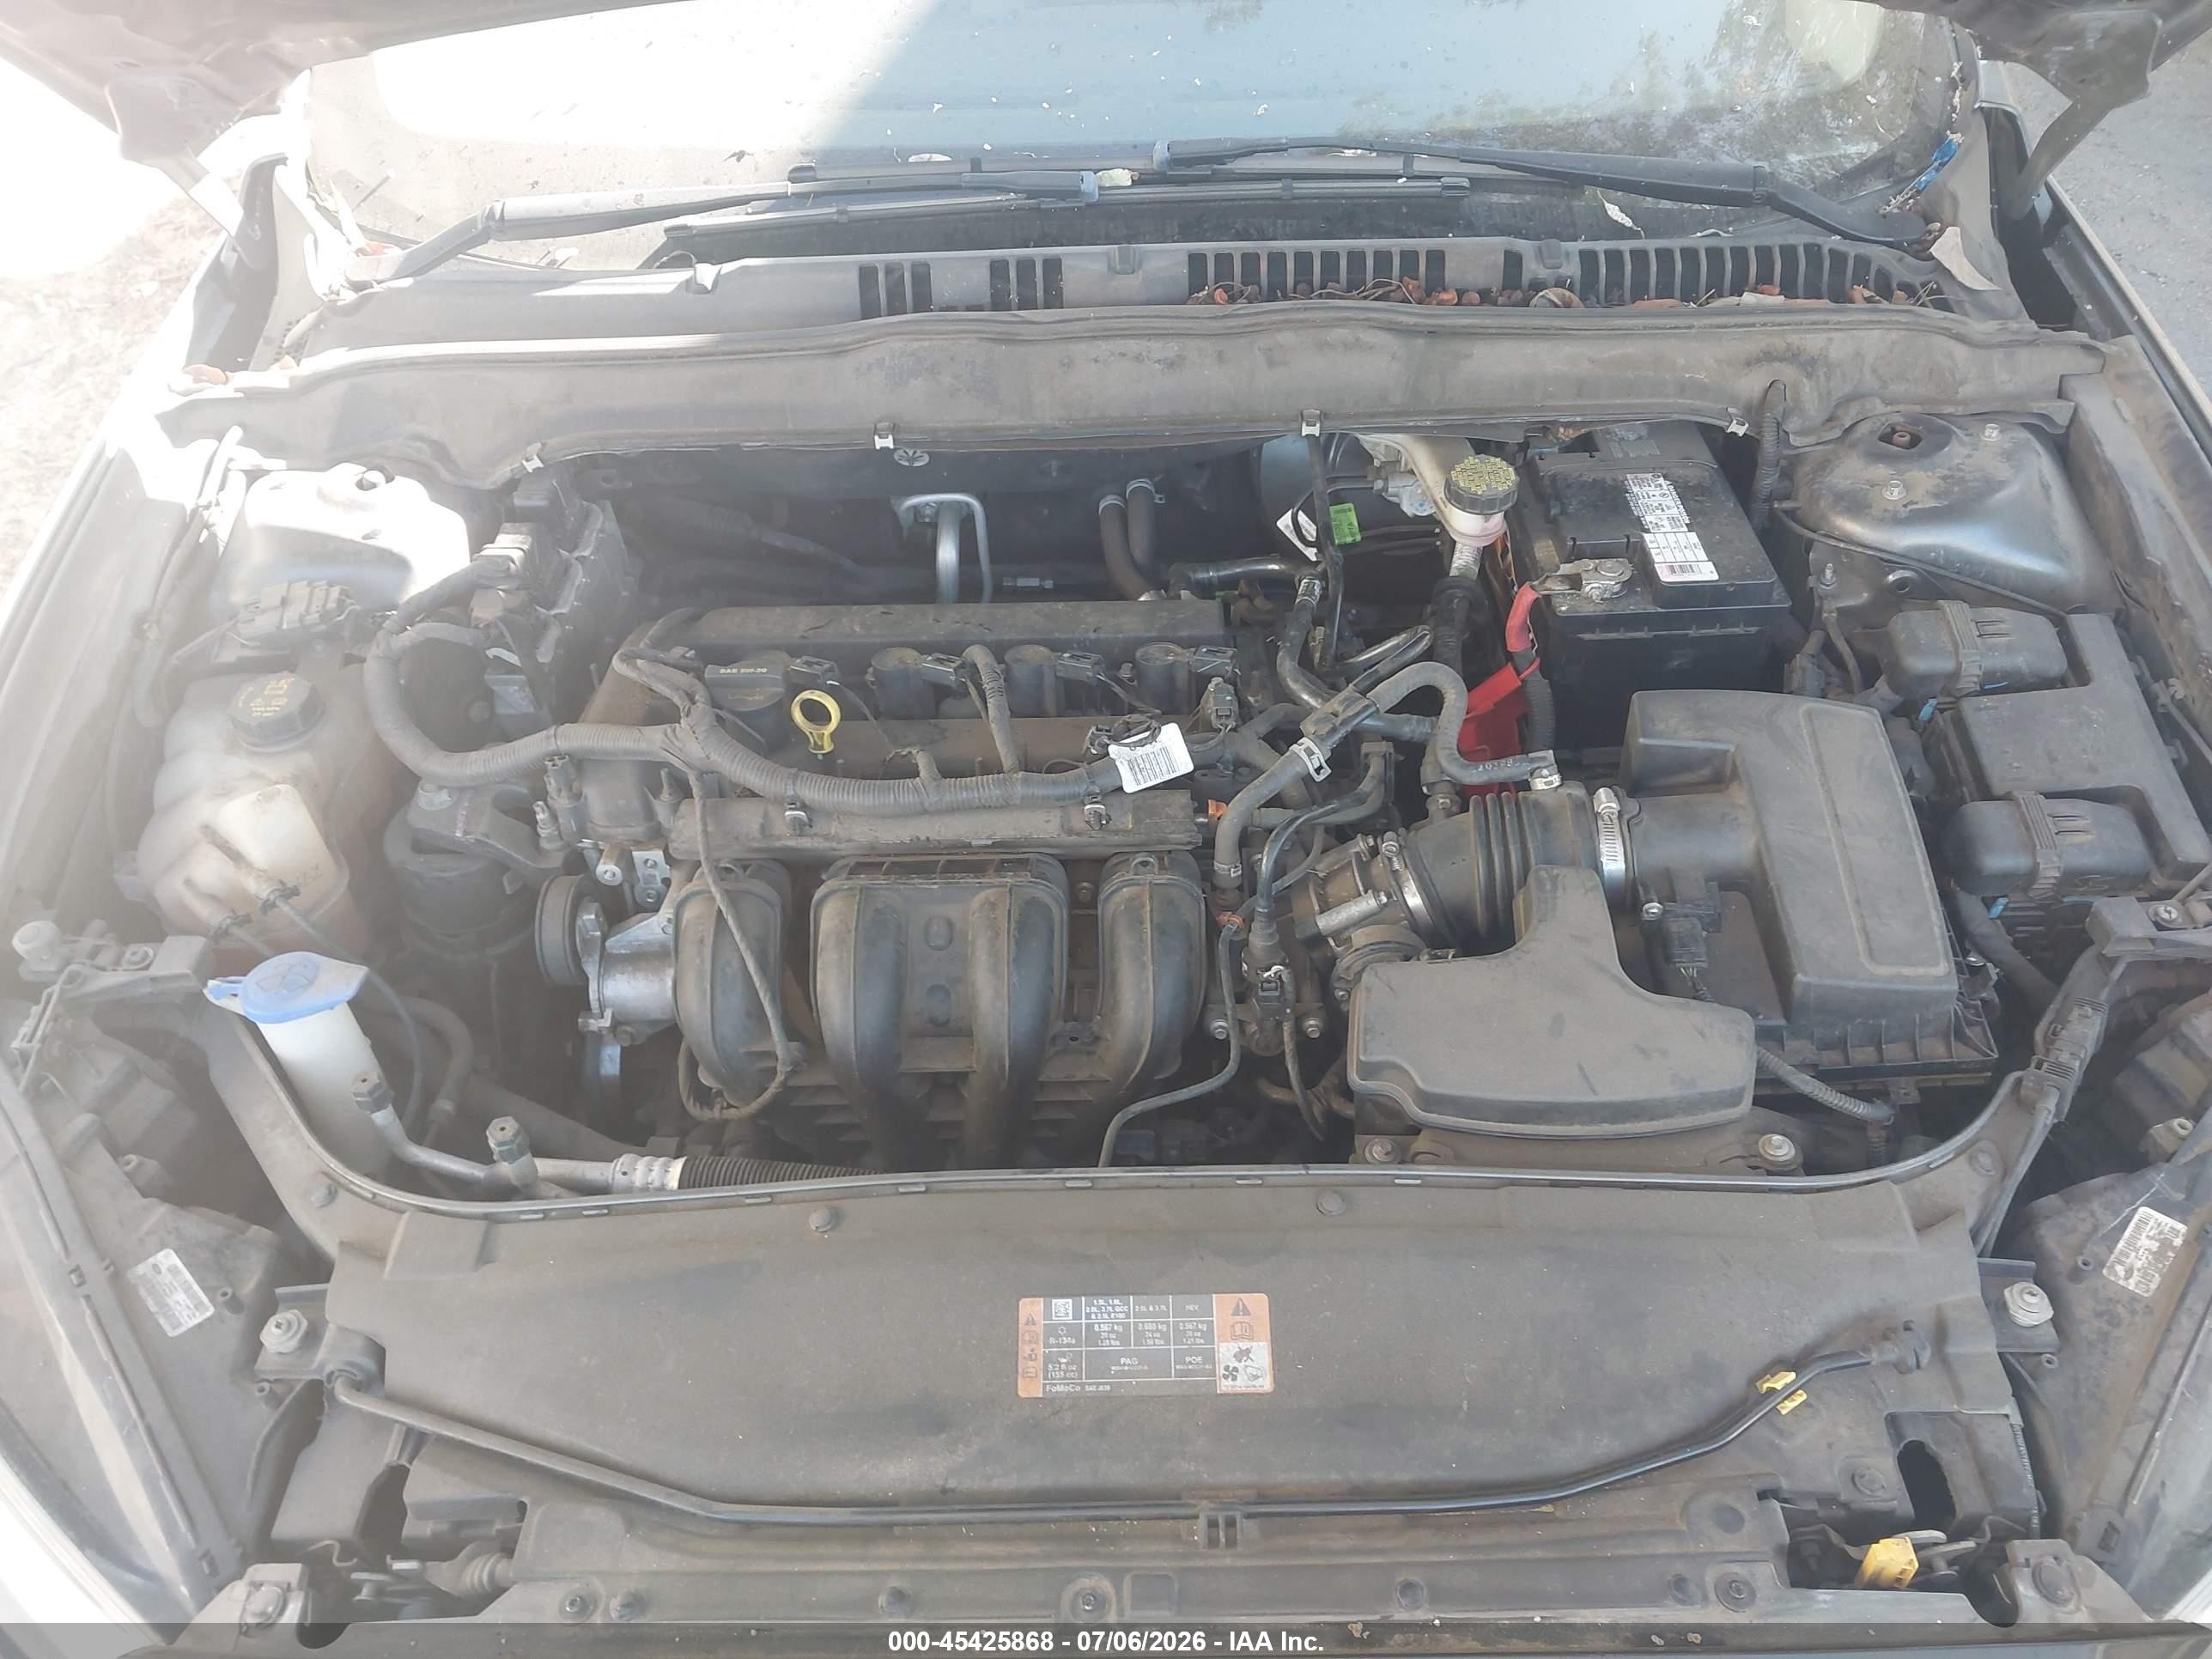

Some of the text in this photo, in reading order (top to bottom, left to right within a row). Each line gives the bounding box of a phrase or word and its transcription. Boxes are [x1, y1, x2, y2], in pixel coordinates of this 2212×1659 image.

[1114, 1324, 1123, 1333] kg
[1120, 1357, 1139, 1365] PAG
[1185, 1356, 1203, 1364] POE
